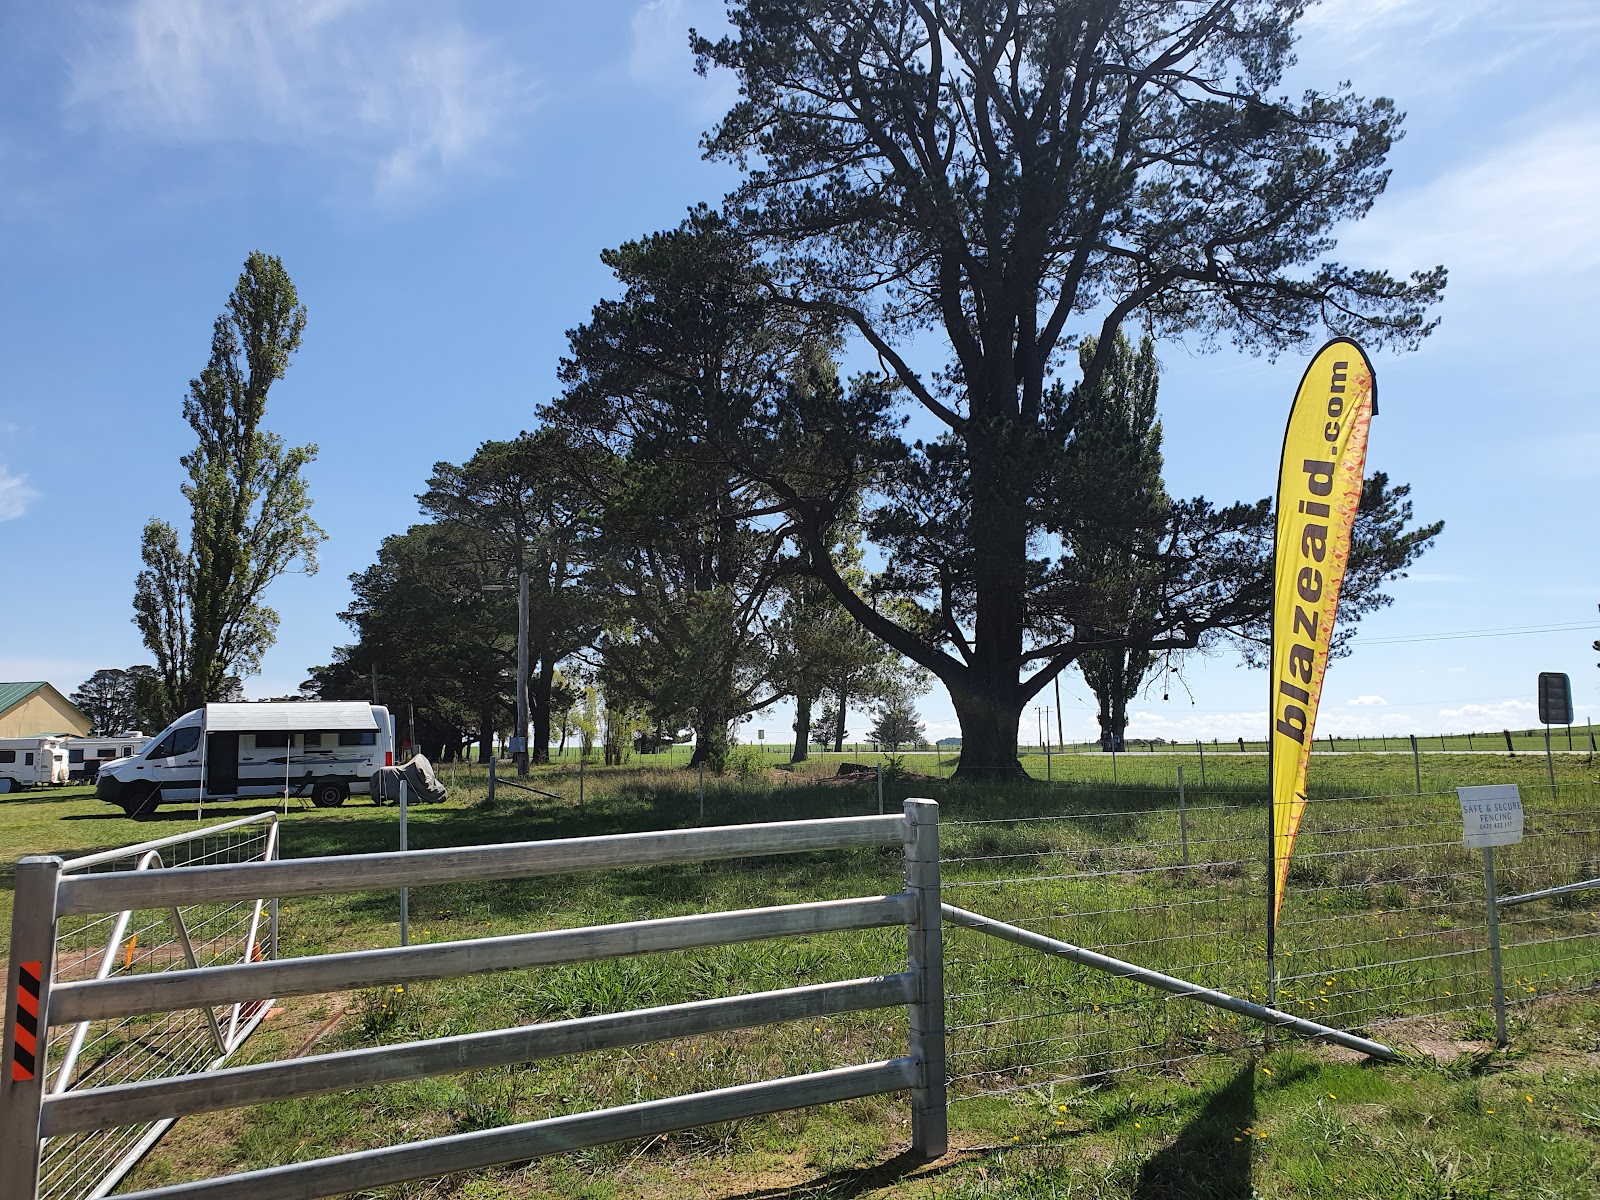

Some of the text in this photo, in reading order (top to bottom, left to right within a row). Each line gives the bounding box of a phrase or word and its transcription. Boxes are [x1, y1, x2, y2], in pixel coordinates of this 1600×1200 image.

[1276, 360, 1349, 747] blazeaid.com
[1463, 801, 1522, 814] SAFE & SECURE
[1480, 812, 1512, 822] FENCING
